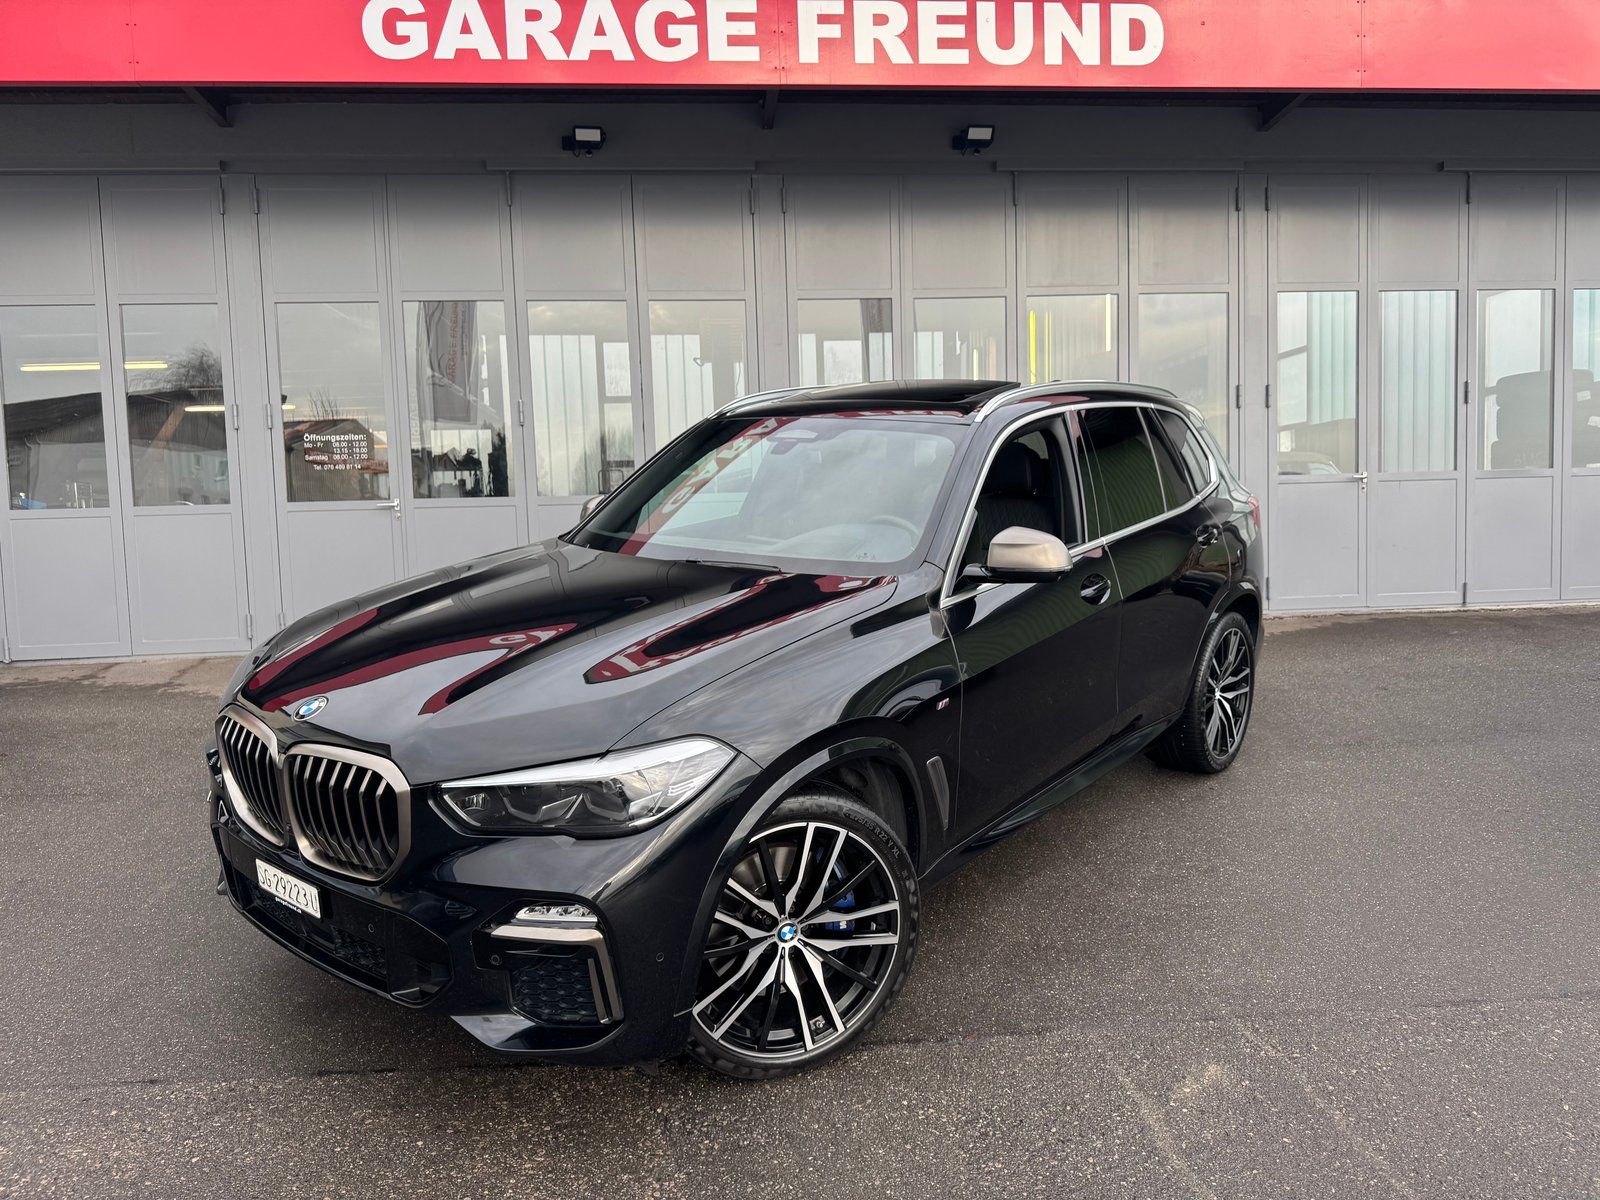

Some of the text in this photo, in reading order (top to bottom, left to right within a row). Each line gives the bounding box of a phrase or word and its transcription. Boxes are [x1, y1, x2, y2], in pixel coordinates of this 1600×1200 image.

[362, 0, 1164, 66] GARAGE FREUND
[304, 433, 367, 442] Öffnungszeiten:
